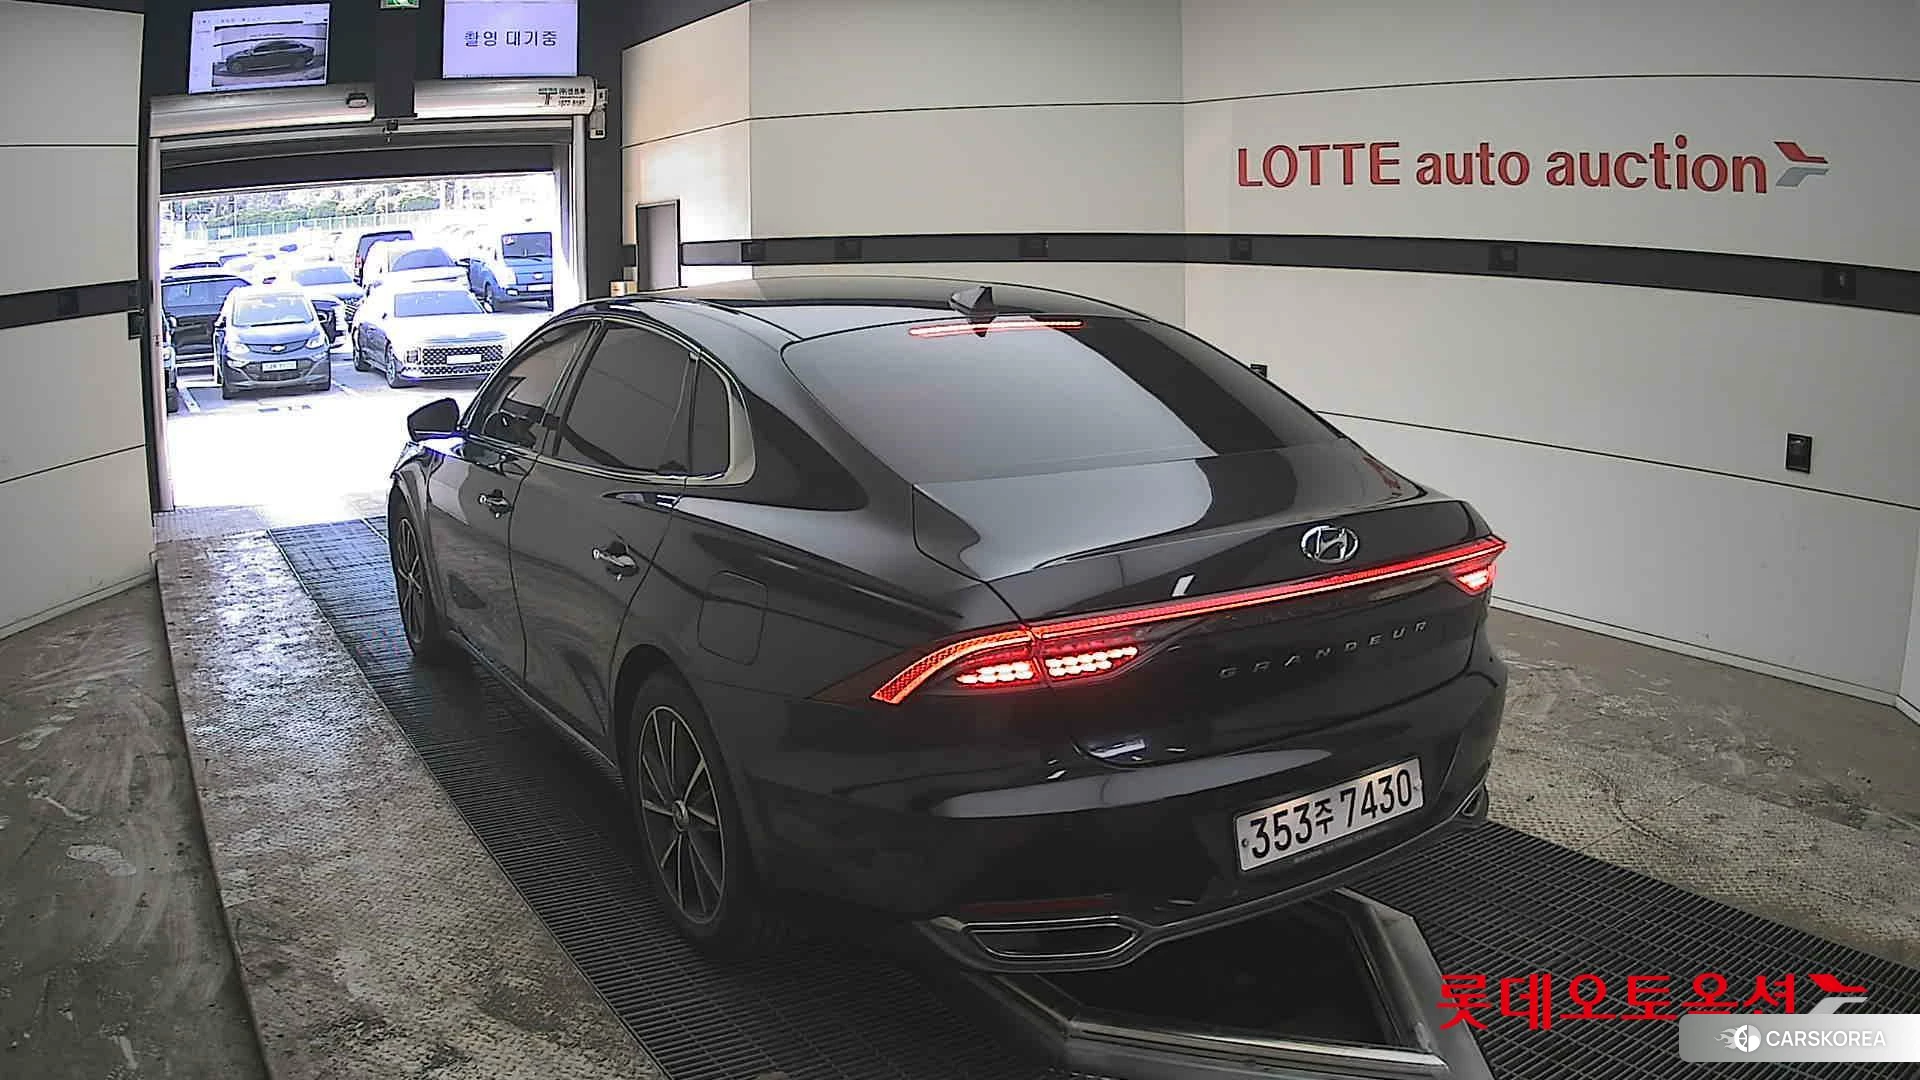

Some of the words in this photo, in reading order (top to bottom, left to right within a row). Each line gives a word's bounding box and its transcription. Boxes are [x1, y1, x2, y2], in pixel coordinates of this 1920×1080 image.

[464, 31, 497, 47] 촬영
[506, 30, 557, 47] 대기중
[1237, 142, 1401, 188] LOTTE
[1416, 142, 1531, 186] auto
[1545, 135, 1767, 194] auction
[1219, 620, 1428, 679] GRANDEUR
[1250, 798, 1334, 859] 353주
[1339, 769, 1412, 828] 7430
